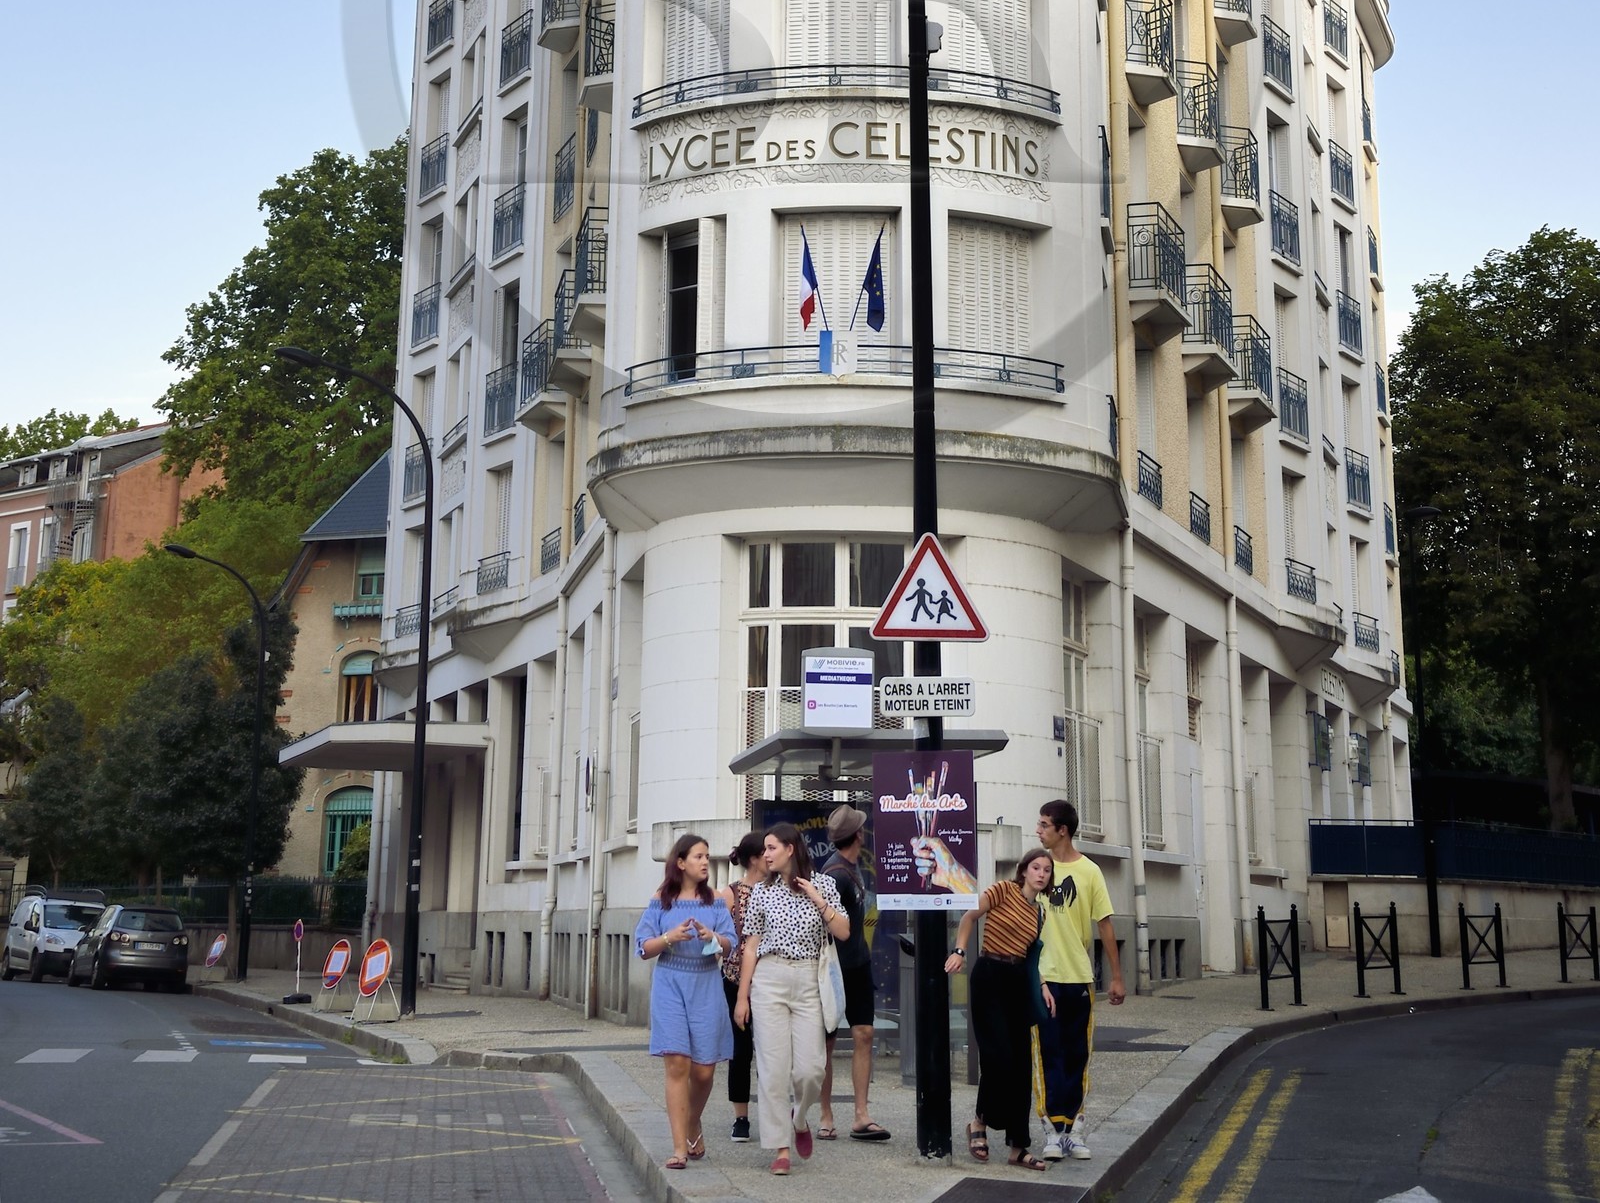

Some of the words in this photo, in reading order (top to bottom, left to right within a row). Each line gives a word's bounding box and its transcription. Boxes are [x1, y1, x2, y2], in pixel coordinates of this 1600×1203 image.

[649, 126, 757, 183] LYCEE
[766, 139, 816, 162] DES
[884, 683, 913, 696] CARS
[916, 683, 925, 695] A
[928, 682, 971, 696] L'ARRET
[884, 699, 929, 711] MOTEUR
[933, 698, 971, 711] ETEINT
[880, 795, 919, 810] Marché
[919, 794, 937, 809] des
[938, 795, 966, 810] Arts
[887, 857, 913, 865] septembre
